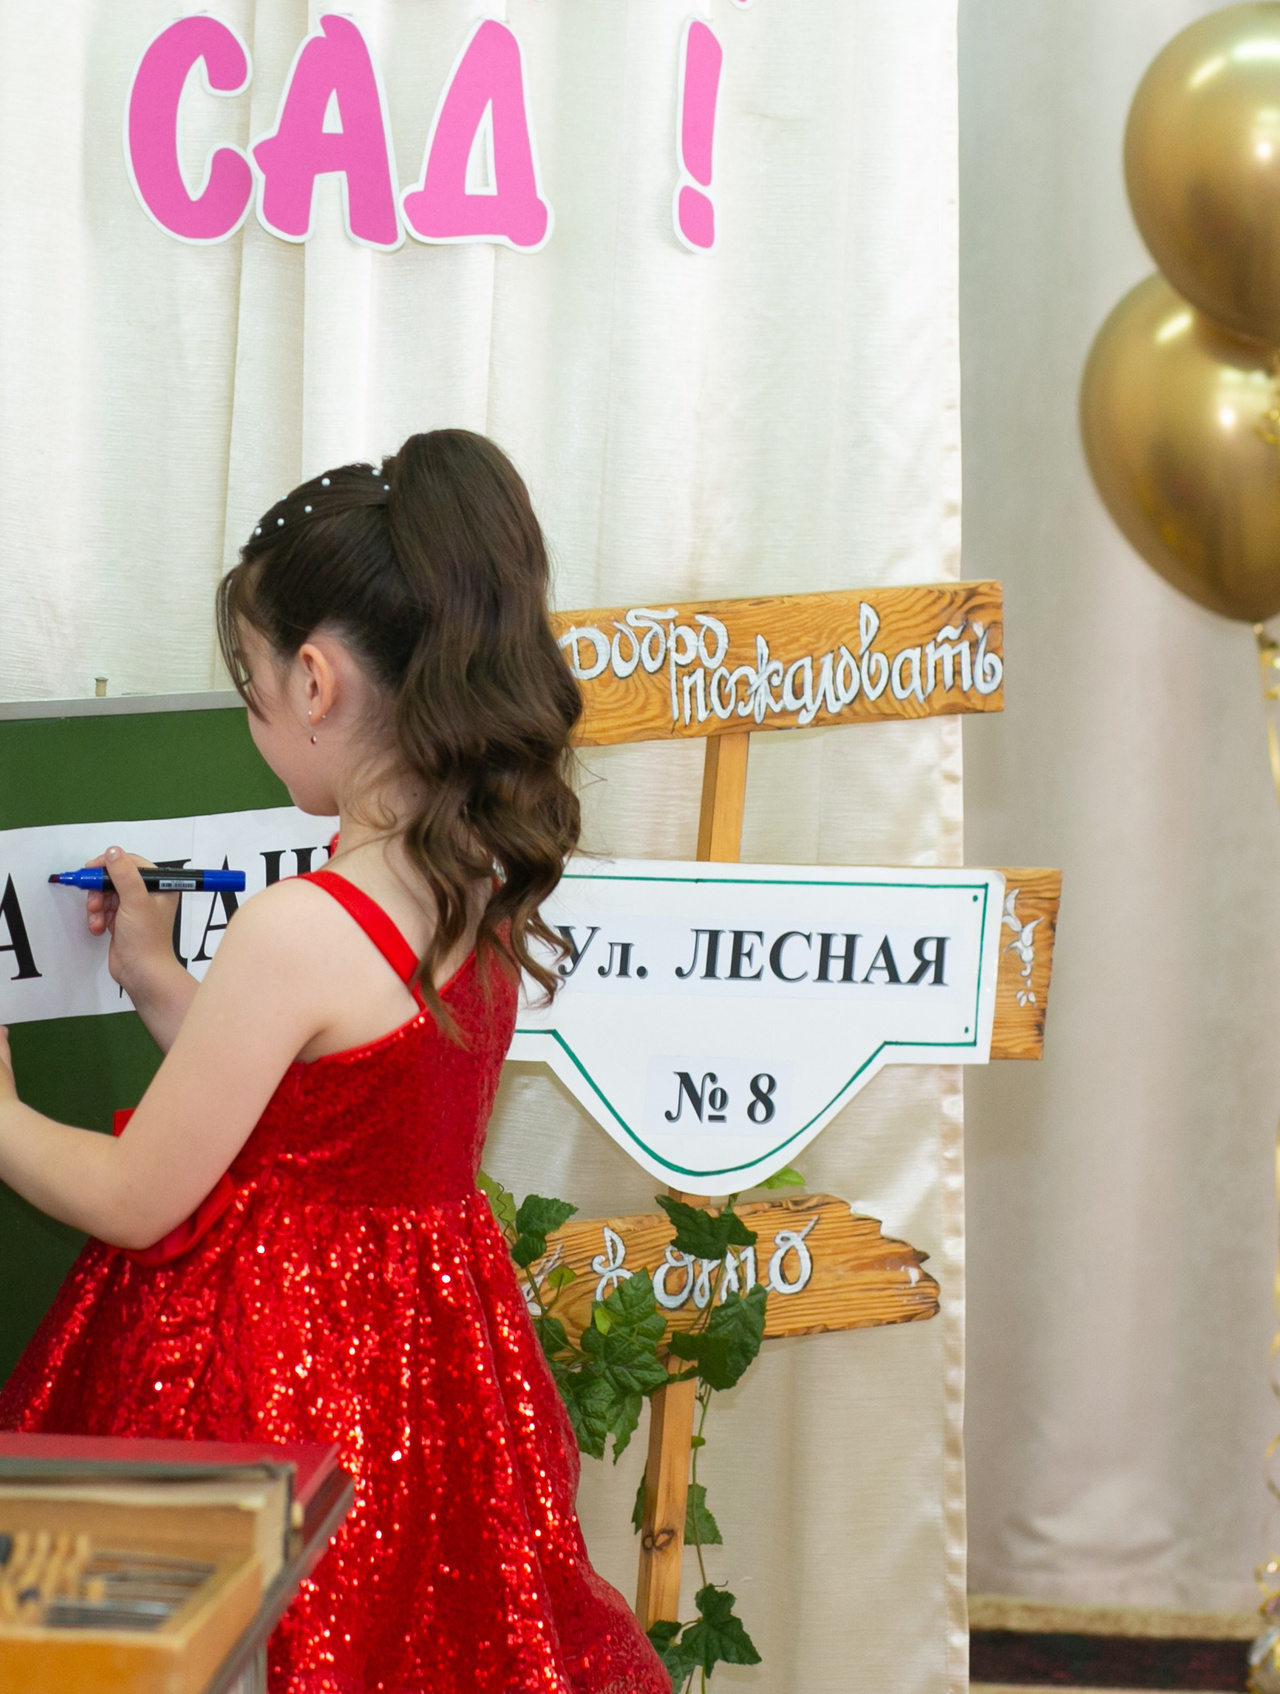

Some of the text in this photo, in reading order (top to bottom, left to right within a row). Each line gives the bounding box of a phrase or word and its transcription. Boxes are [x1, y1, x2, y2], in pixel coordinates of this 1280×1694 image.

[128, 13, 548, 248] САД
[553, 925, 951, 987] Ул. ЛЕСНАЯ
[664, 1071, 777, 1125] № 8
